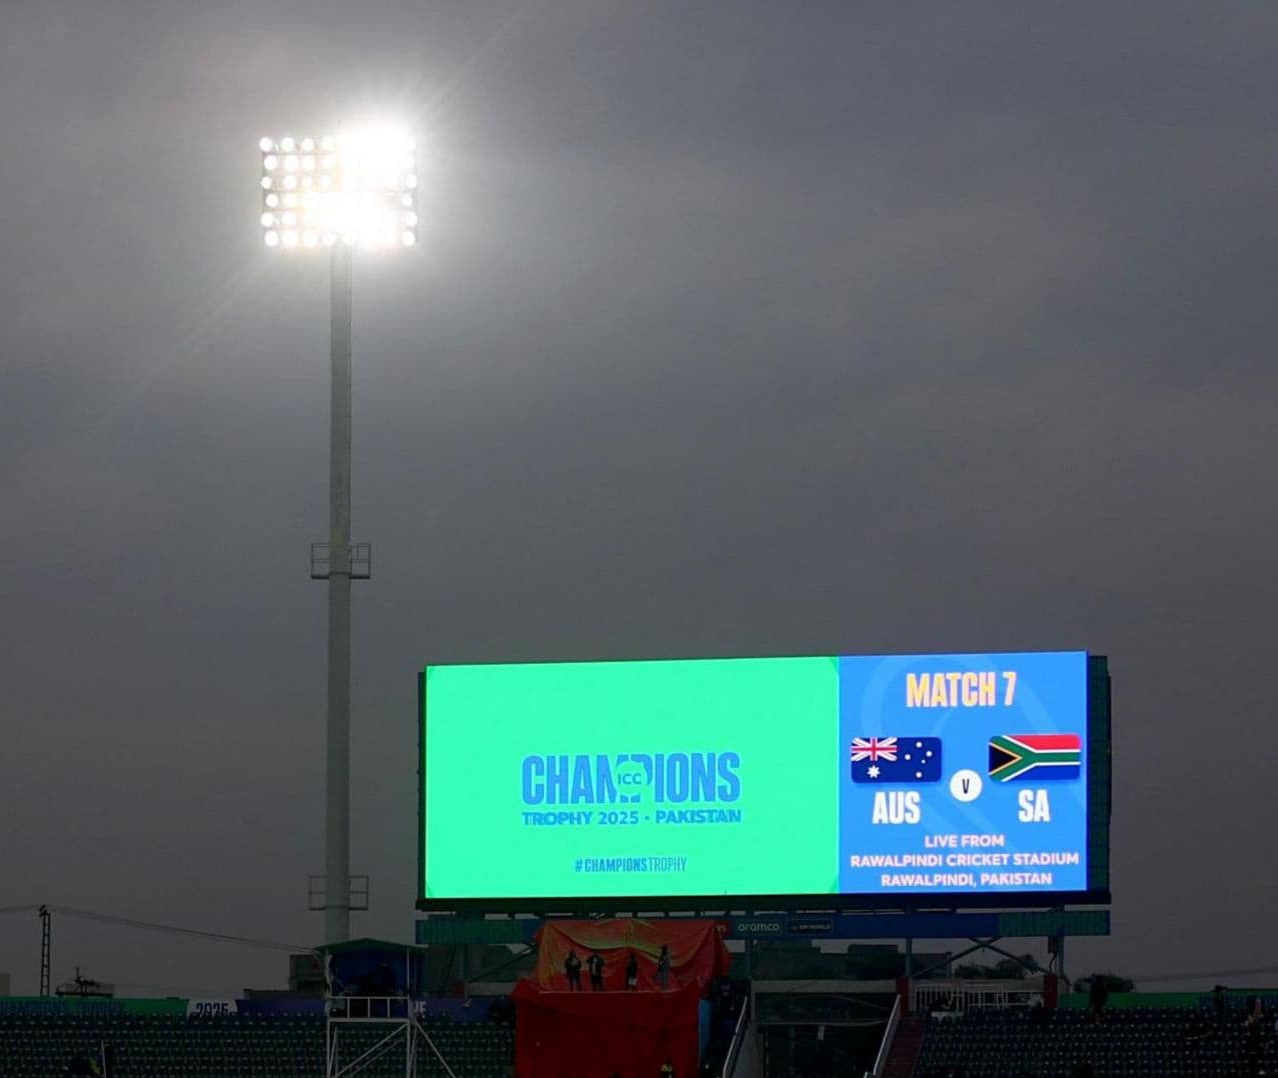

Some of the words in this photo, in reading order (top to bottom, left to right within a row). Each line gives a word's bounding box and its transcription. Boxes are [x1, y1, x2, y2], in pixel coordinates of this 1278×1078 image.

[906, 672, 996, 708] MATCH
[1003, 671, 1016, 706] 7
[522, 752, 741, 805] CHAMPIONS
[618, 773, 642, 785] ICC
[872, 791, 921, 824] AUS
[1018, 789, 1051, 823] SA
[522, 811, 593, 826] TROPHY
[598, 811, 639, 825] 2025
[656, 809, 742, 824] PAKISTAN
[925, 835, 957, 848] LIVE
[961, 834, 1005, 848] FROM
[575, 857, 687, 873] #CHAMPIONSTROPHY
[851, 855, 942, 868] RAWALPINDI
[946, 854, 1008, 866] CRICKET
[1013, 852, 1079, 866] STADIUM
[881, 874, 977, 888] RAWALPINDI,
[981, 872, 1052, 886] PAKISTAN
[738, 922, 780, 932] aramco
